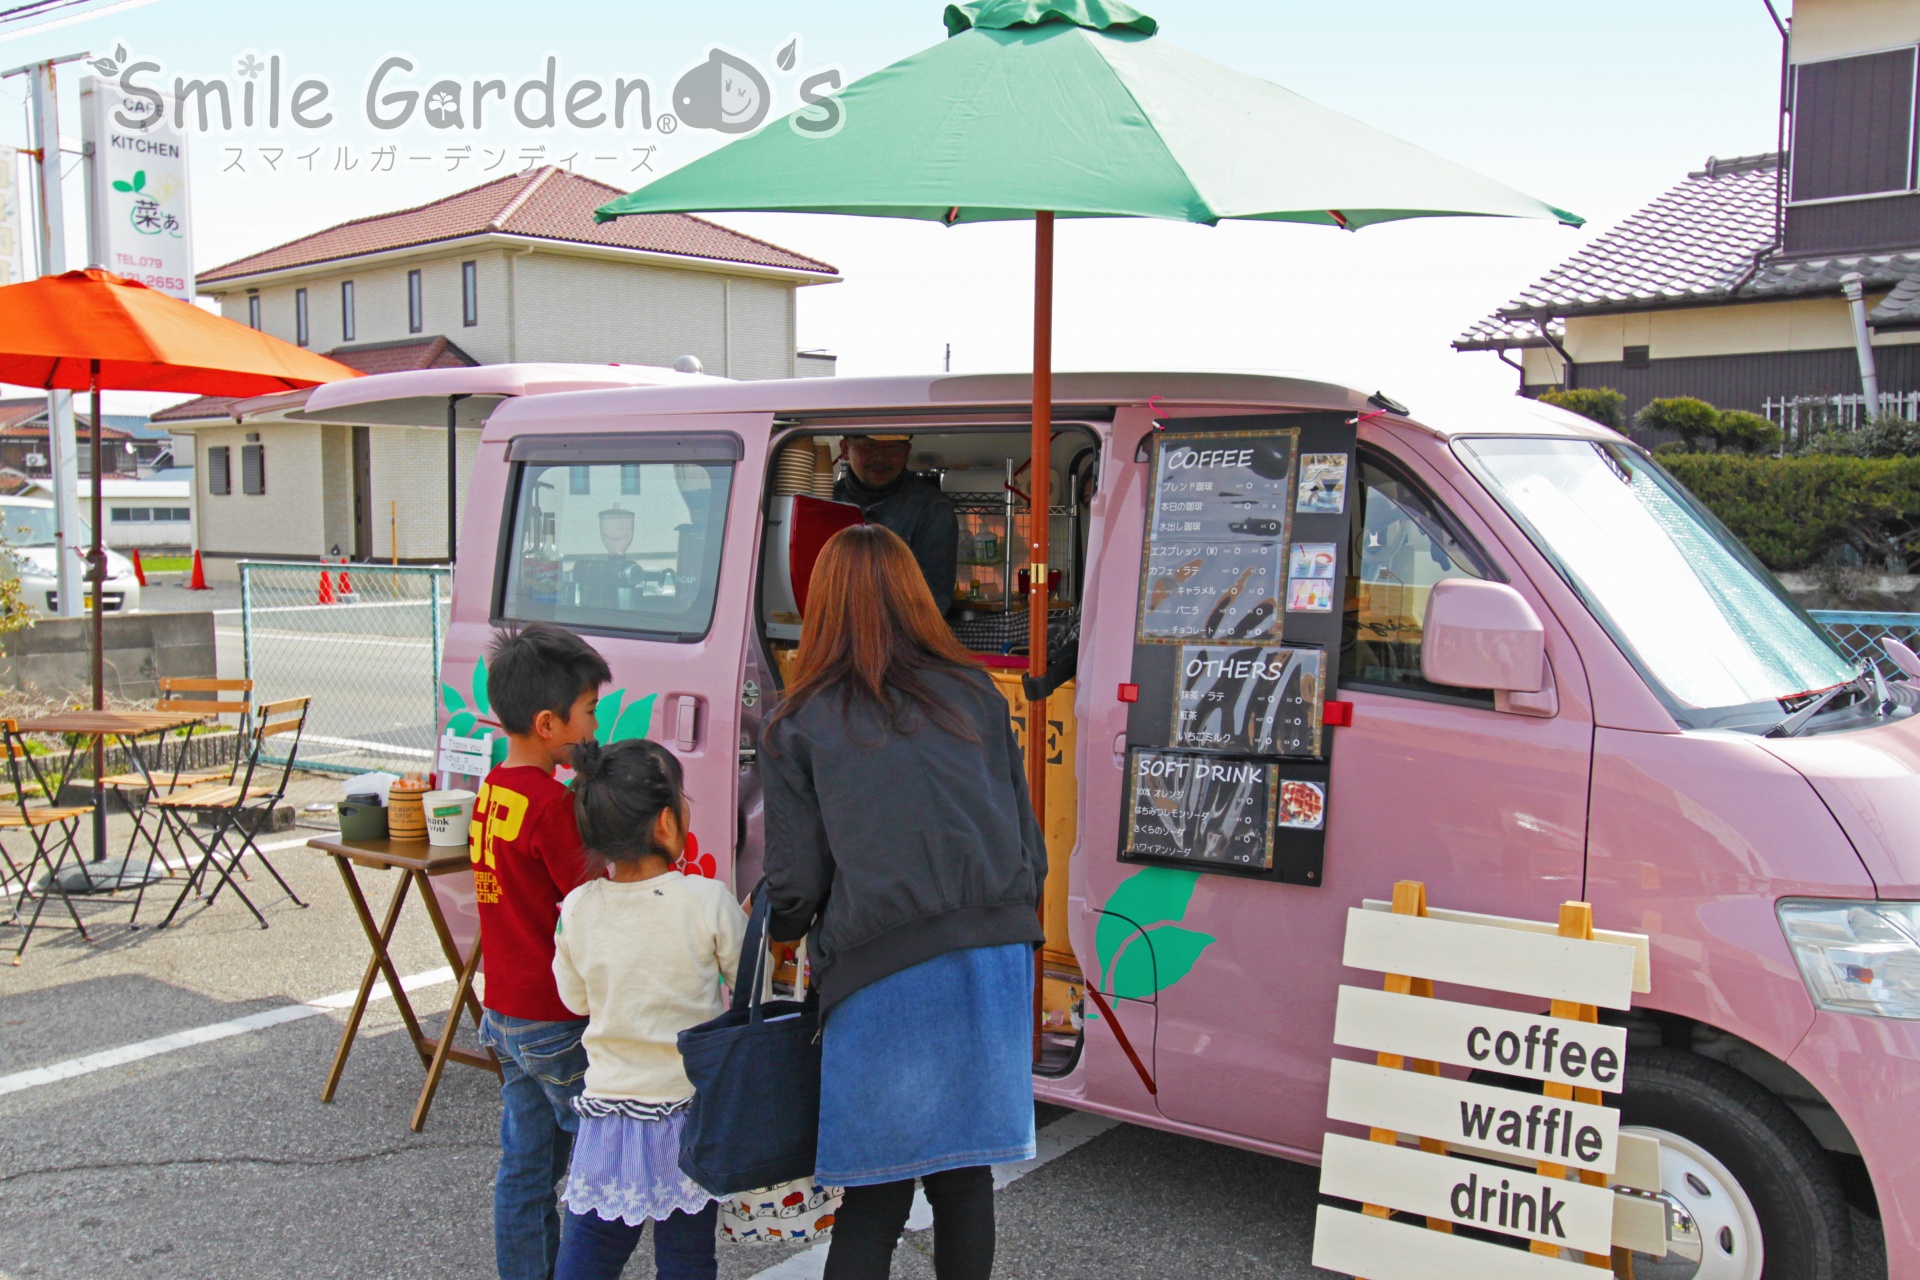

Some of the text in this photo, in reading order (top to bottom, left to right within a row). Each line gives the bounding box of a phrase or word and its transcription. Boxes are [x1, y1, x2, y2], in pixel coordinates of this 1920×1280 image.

[123, 98, 165, 117] CAFE
[111, 134, 180, 158] KITCHEN
[1168, 449, 1255, 470] COFFEE
[1162, 481, 1213, 492] ブレンド珈琲
[1160, 502, 1203, 512] 本日の珈琲
[1159, 522, 1202, 532] 水出し珈琲
[1177, 586, 1217, 595] キャラメル
[1171, 626, 1214, 635] チョコレート
[1186, 658, 1282, 681] OTHERS
[1179, 710, 1197, 720] 紅茶
[1178, 732, 1231, 743] いちごミルク
[1139, 760, 1263, 784] SOFT DRINK
[1154, 789, 1185, 799] オレンジ
[1135, 806, 1210, 821] はちみつレモンソーダ
[426, 817, 449, 826] hank
[1133, 825, 1186, 838] さくらのソーダ
[1132, 843, 1192, 857] ハワイアンソーダ
[1466, 1024, 1619, 1083] coffee
[1460, 1100, 1603, 1163] waffle
[1450, 1172, 1567, 1239] drink
